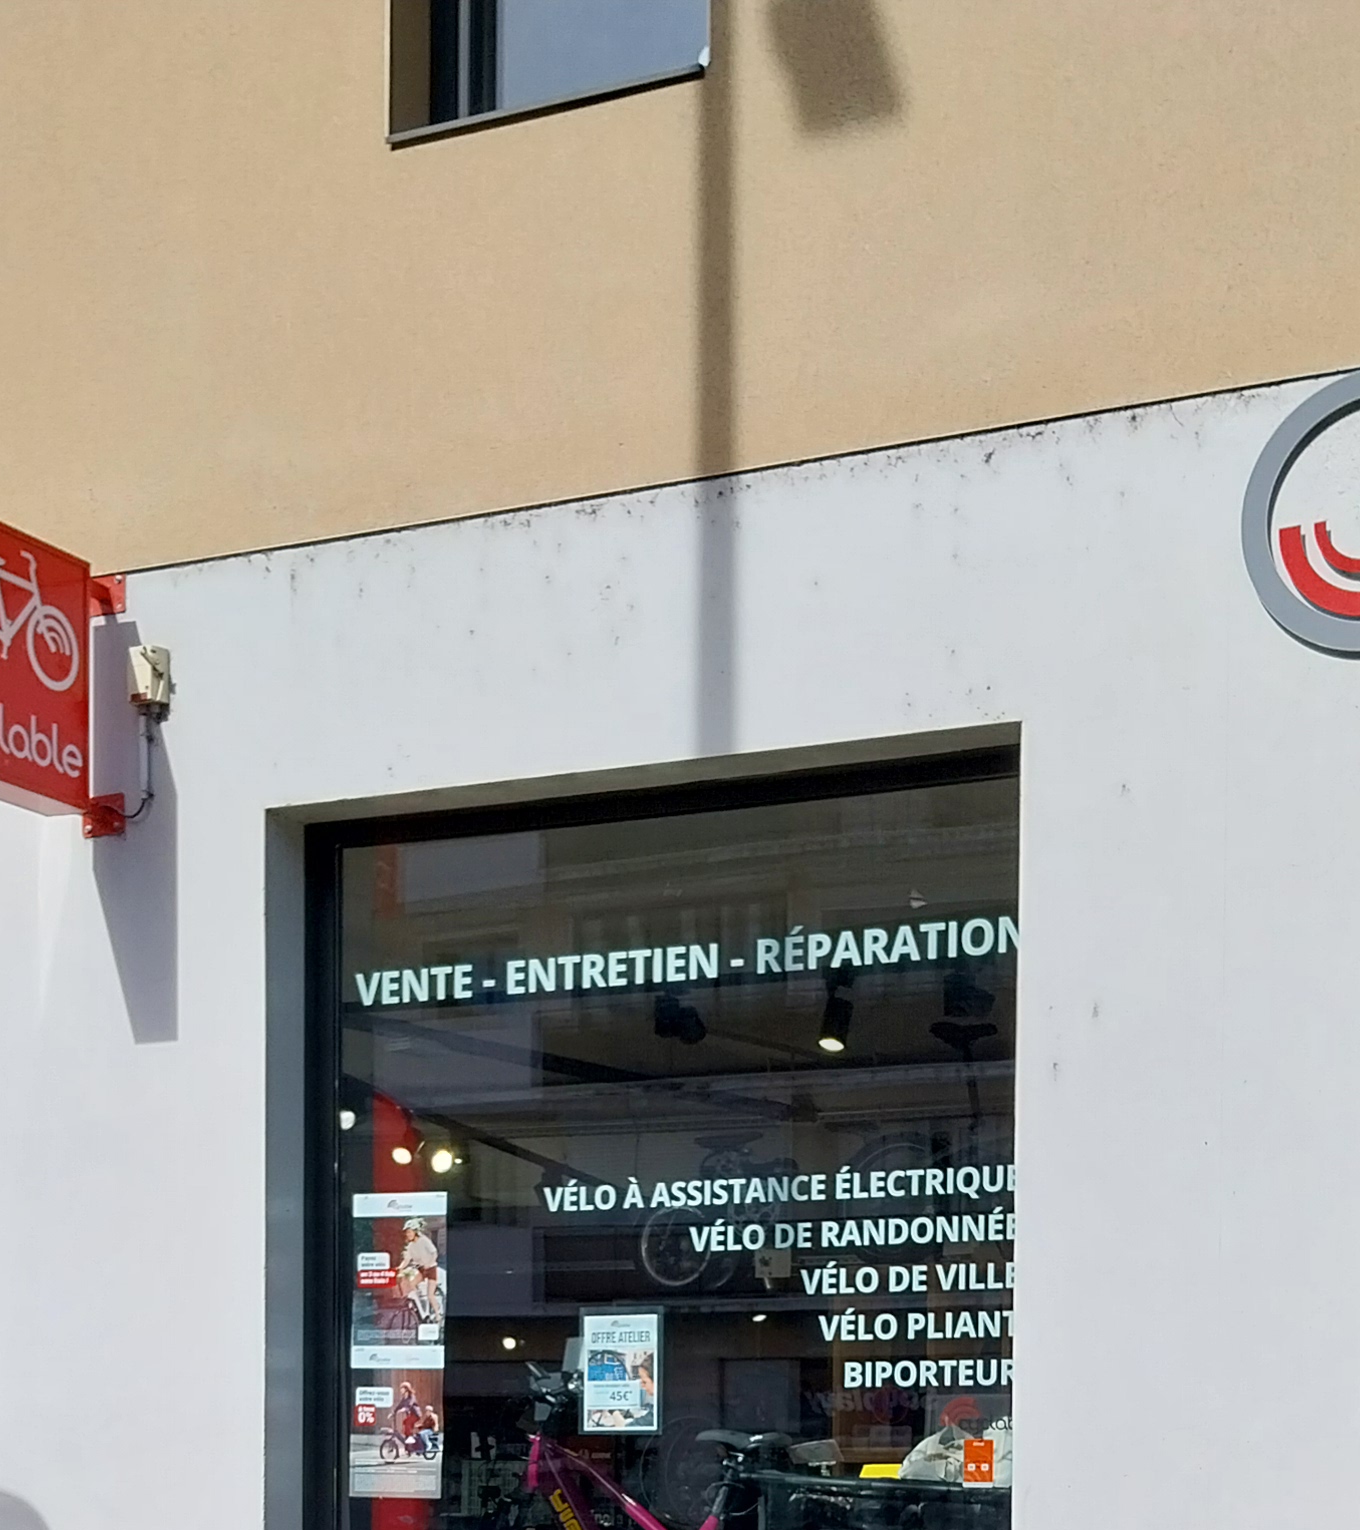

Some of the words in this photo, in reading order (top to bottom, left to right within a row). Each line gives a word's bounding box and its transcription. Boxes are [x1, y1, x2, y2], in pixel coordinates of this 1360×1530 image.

[355, 964, 473, 1007] VENTE
[507, 943, 719, 996] ENTRETIEN
[756, 916, 1019, 975] RÉPARATION
[543, 1179, 616, 1212] VÉLO
[623, 1176, 644, 1209] À
[650, 1174, 827, 1208] ASSISTANCE
[690, 1219, 765, 1252] VÉLO
[775, 1222, 812, 1249] DE
[800, 1261, 879, 1295] VÉLO
[889, 1265, 927, 1292] DE
[591, 1331, 616, 1344] OFFRE
[619, 1330, 651, 1343] ATELIER
[818, 1308, 898, 1341] VÉLO
[907, 1311, 1015, 1340] PLIANT
[357, 1412, 375, 1424] 0%
